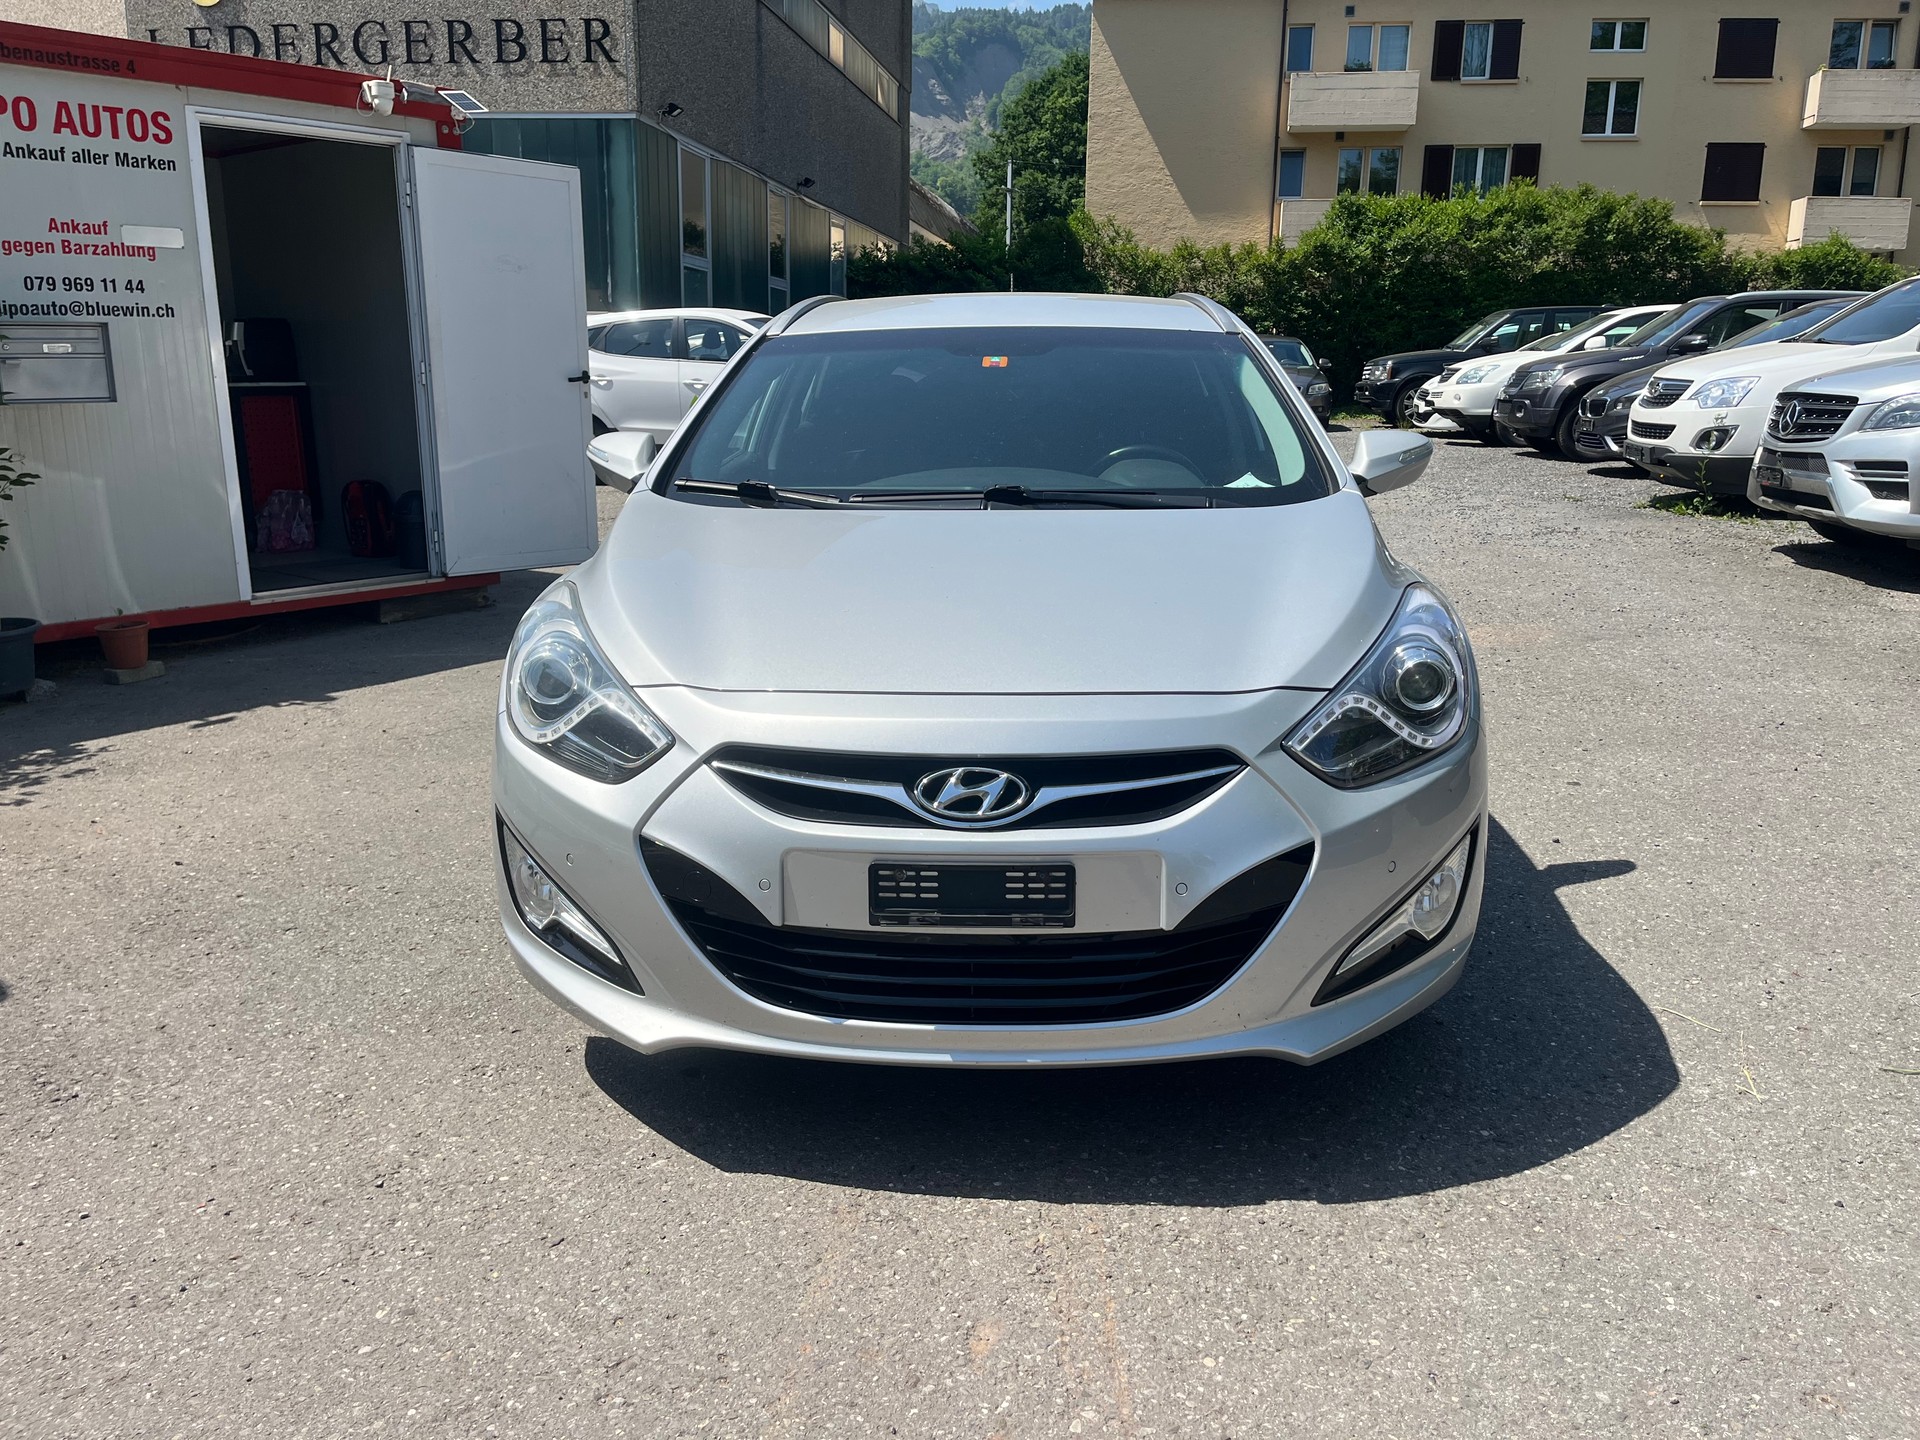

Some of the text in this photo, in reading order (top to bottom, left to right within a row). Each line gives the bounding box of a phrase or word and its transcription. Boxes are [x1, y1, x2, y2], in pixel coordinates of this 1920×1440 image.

[0, 41, 136, 74] benaustrasse 4
[53, 101, 173, 145] AUTOS
[2, 141, 177, 171] Ankauf aller Marken
[48, 217, 109, 235] Ankauf
[1, 239, 157, 262] gegen Barzahlung
[23, 276, 145, 294] 079 969 11 44
[0, 300, 175, 319] ipoauto@bluewin.ch
